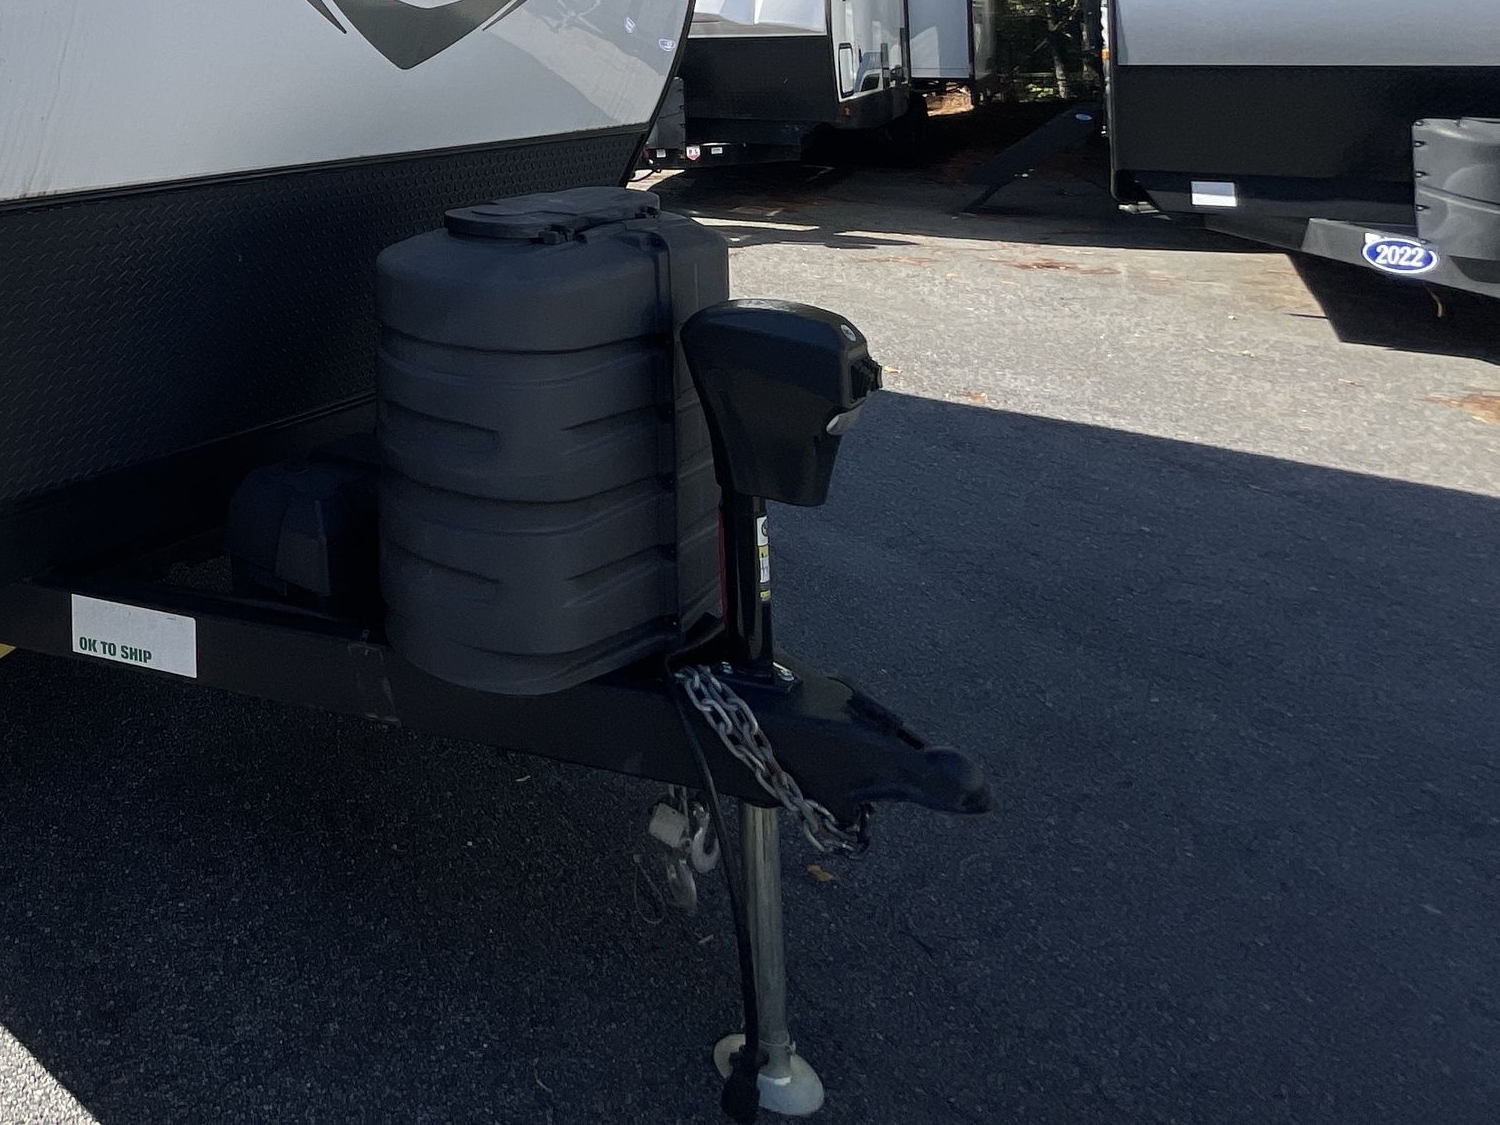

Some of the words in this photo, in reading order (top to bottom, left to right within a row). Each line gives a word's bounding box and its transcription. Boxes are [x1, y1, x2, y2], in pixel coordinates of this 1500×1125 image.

[1375, 244, 1425, 268] 2022
[79, 636, 98, 653] OK
[100, 641, 117, 657] TO
[120, 645, 152, 664] SHIP
